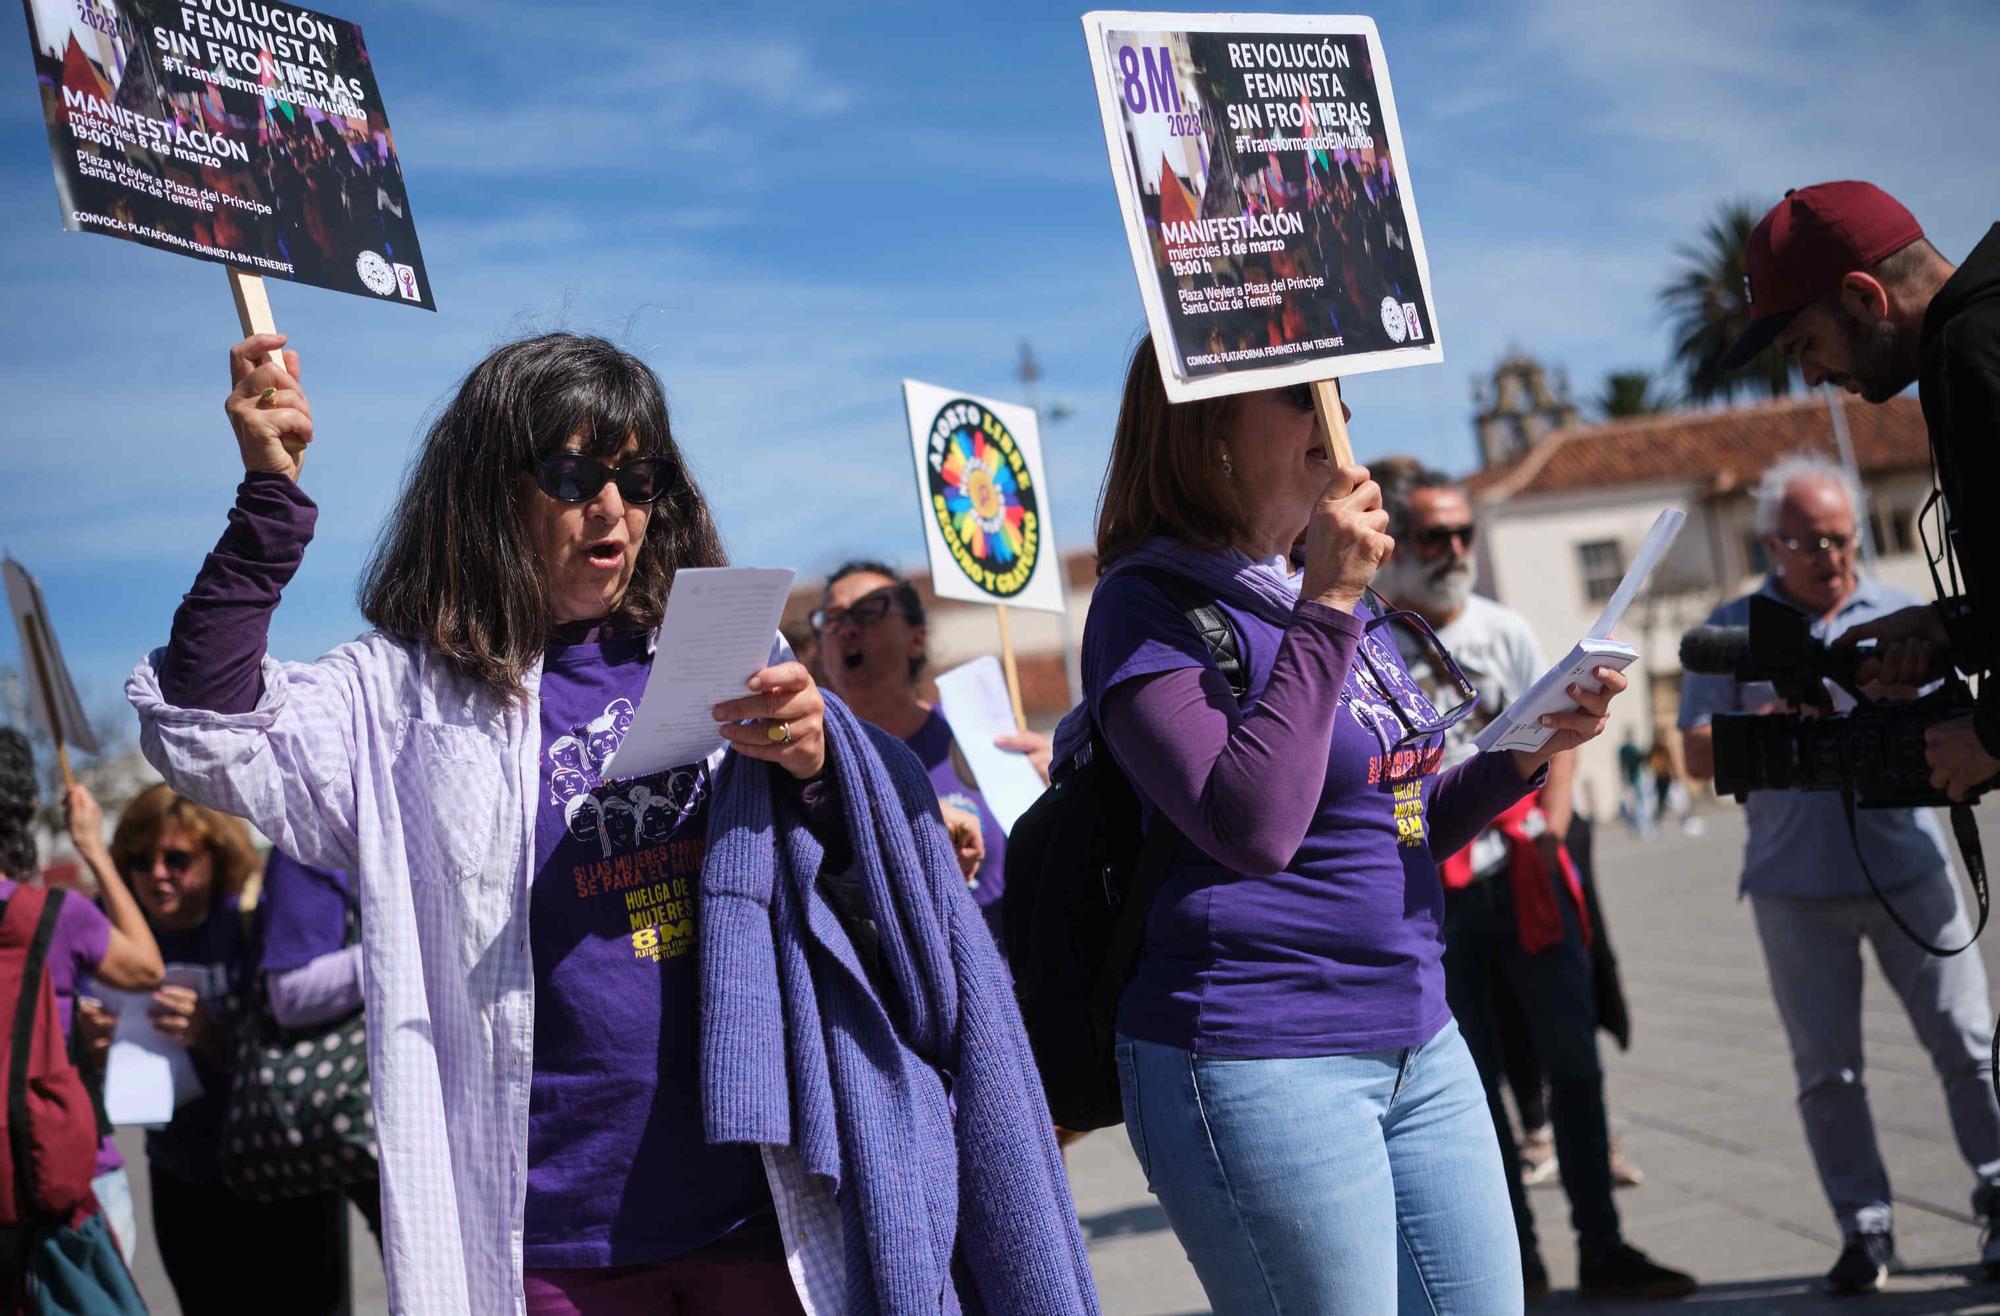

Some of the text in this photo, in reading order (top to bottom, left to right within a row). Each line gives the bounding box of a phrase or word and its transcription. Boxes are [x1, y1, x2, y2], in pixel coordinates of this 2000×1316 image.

[77, 4, 117, 39] 2023
[181, 7, 328, 68] FEMINISTA
[154, 27, 365, 101] SIN FRONTERAS
[1228, 38, 1350, 68] REVOLUCIÓN
[162, 55, 368, 120] #TransformandoElMundo
[1119, 45, 1181, 114] 8M
[1243, 73, 1345, 98] FEMINISTA
[62, 85, 249, 162] MANIFESTACIÓN
[1168, 114, 1201, 137] 2023
[1227, 102, 1371, 129] SIN FRONTERAS
[69, 111, 222, 168] miércoles 8 de marzo
[70, 123, 125, 152] 19:00 h
[1235, 132, 1374, 153] #TransformandoElMundo
[77, 150, 273, 215] Plaza Weyler a Plaza del Príncipe
[79, 162, 214, 212] Santa Cruz de Tenerife
[72, 211, 295, 273] CONVOCA: PLATAFORMA FEMINISTA 8M TENERIFE
[1161, 207, 1304, 245] MANIFESTACIÓN
[1168, 239, 1286, 261] miércoles 8 de marzo
[1170, 258, 1212, 276] 19:00 h
[1178, 275, 1324, 302] Plaza Weyler a Plaza del Príncipe
[1181, 293, 1282, 315] Santa Cruz de Tenerife
[1186, 337, 1344, 366] CONVOCA: PLATAFORMA FEMINISTA 8M TENERIFE
[929, 404, 1031, 490] ABORTO LIBRE
[934, 494, 1037, 593] SEGURO Y GRATUITO
[1397, 815, 1423, 835] 8M
[576, 878, 598, 898] SE
[602, 868, 645, 892] PARA
[648, 861, 668, 880] EL
[589, 860, 612, 880] LAS
[615, 846, 668, 871] MUJERES
[625, 877, 689, 911] HUELGA DE
[629, 899, 693, 931] MUJERES
[631, 919, 694, 950] 8M
